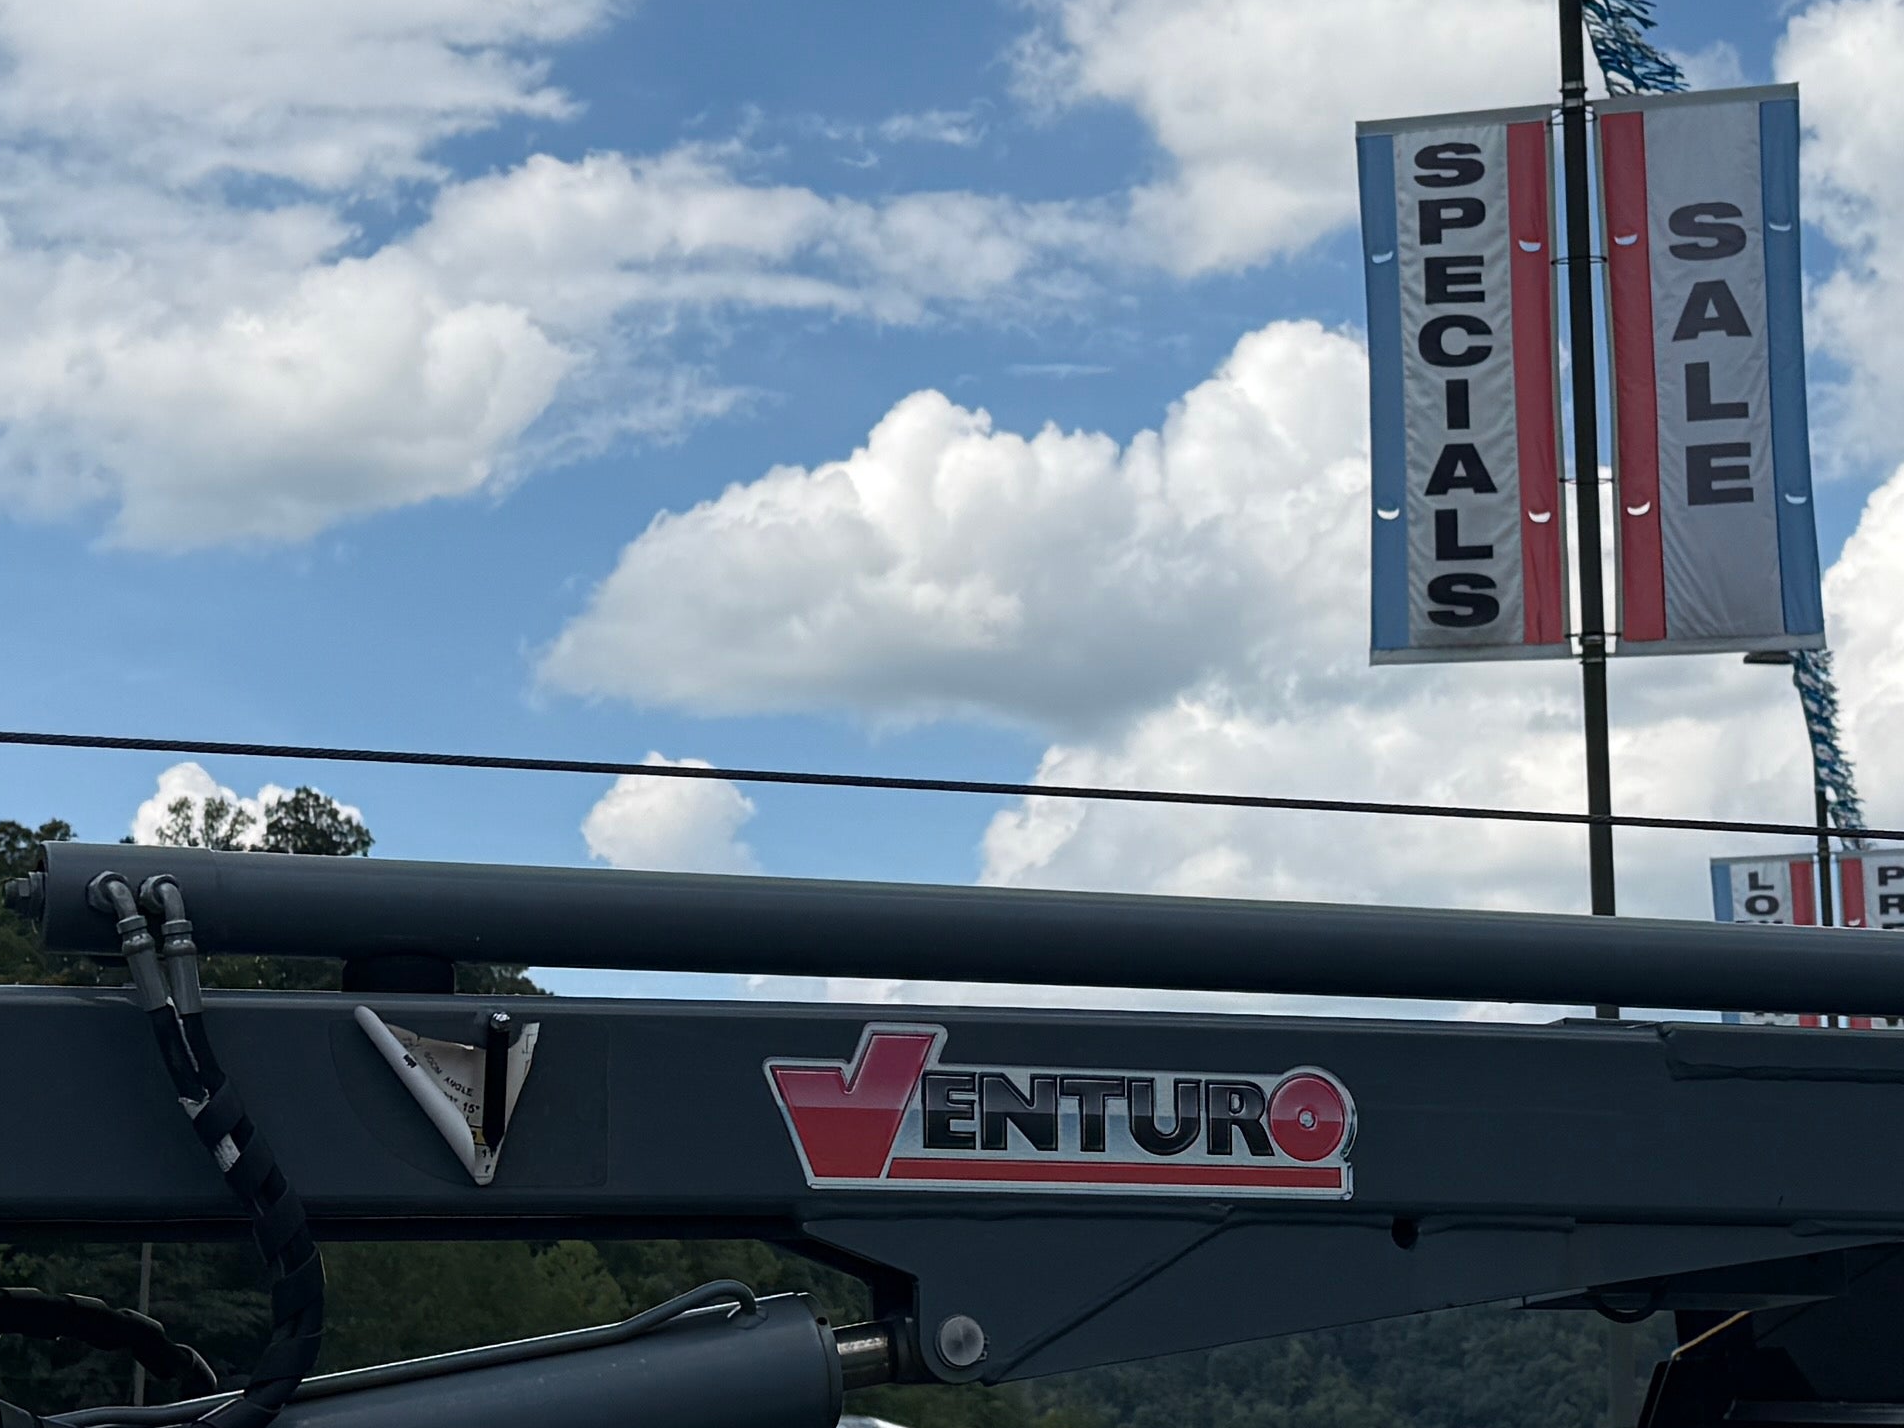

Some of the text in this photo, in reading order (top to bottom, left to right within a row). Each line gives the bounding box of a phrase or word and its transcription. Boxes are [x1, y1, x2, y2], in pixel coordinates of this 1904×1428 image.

[1414, 143, 1500, 628] SPECIALS
[1668, 202, 1754, 507] SALE
[1735, 871, 1784, 924] LO
[443, 1076, 474, 1097] ANGLE
[768, 1027, 1352, 1184] VENTURO
